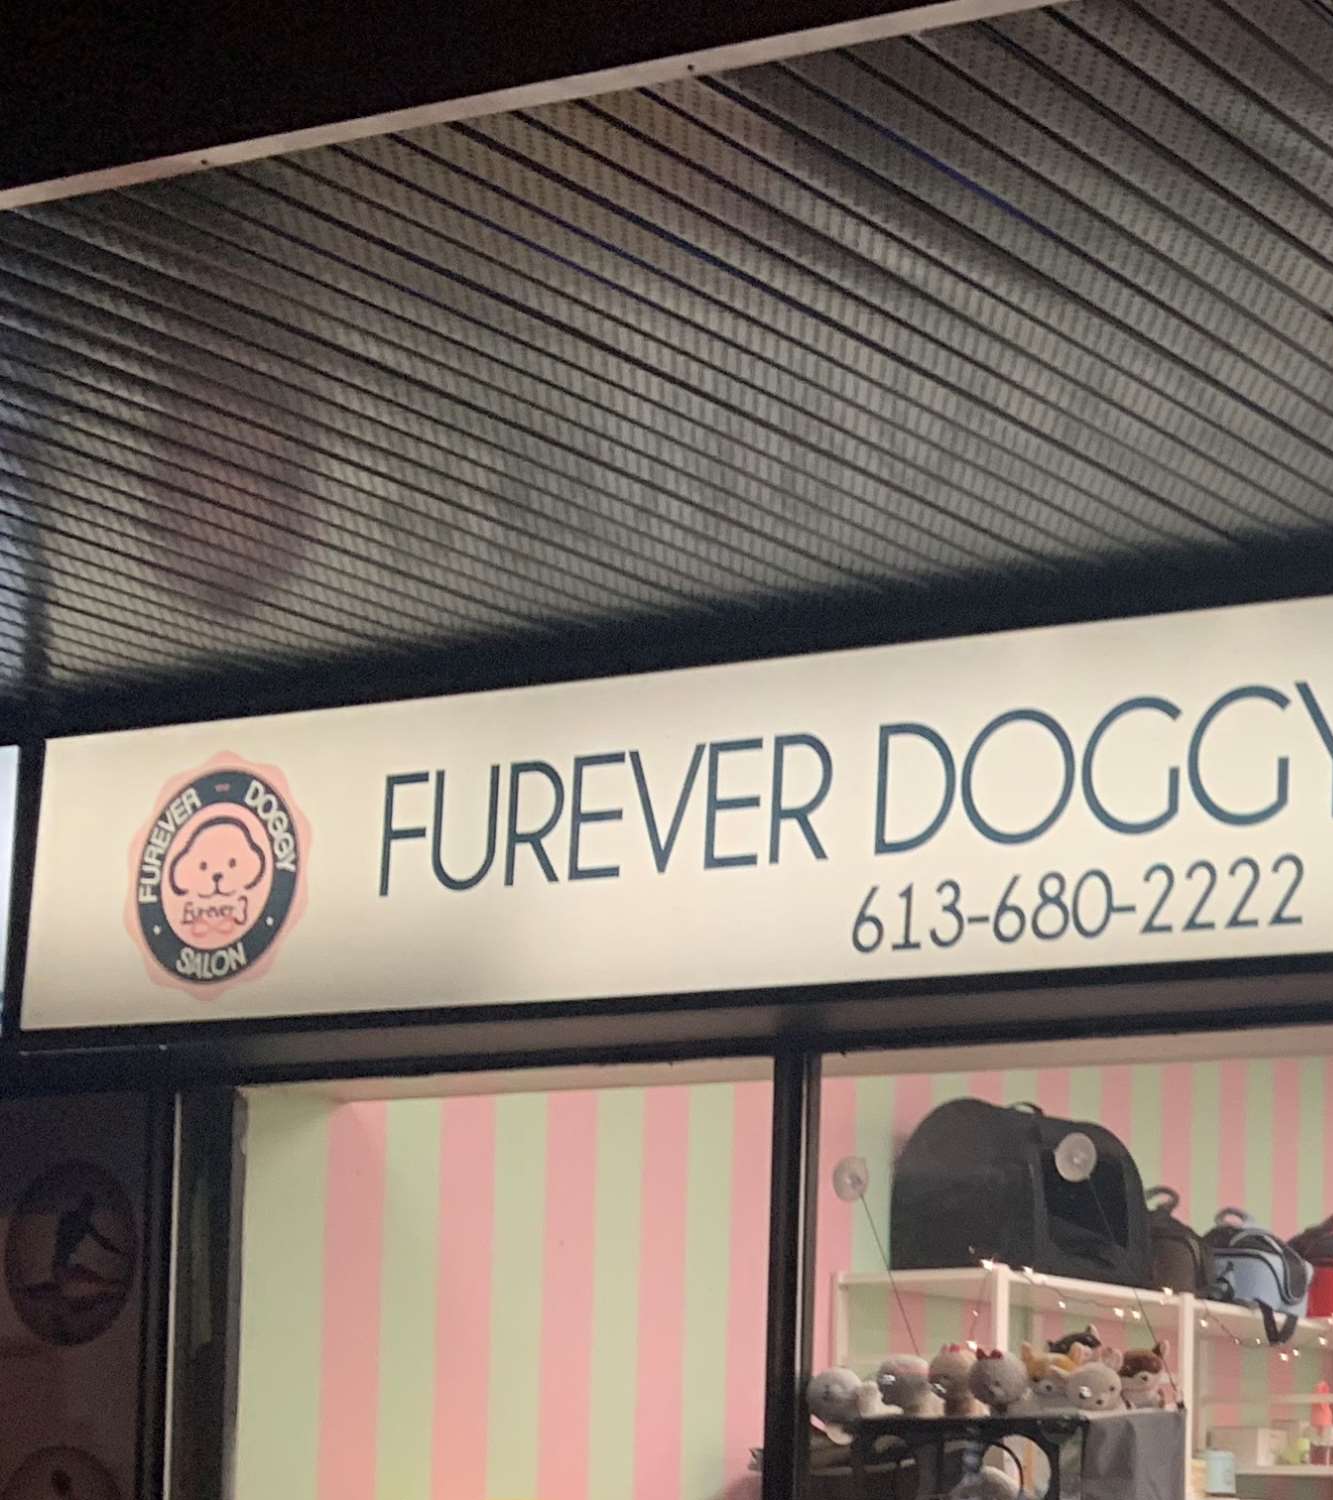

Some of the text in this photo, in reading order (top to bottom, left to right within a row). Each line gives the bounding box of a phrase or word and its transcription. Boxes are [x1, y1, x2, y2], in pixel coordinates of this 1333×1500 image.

[139, 779, 297, 904] FUREVER DOGGY
[378, 732, 833, 897] FUREVER
[851, 853, 1305, 954] 613-680-2222
[175, 942, 248, 979] SALON
